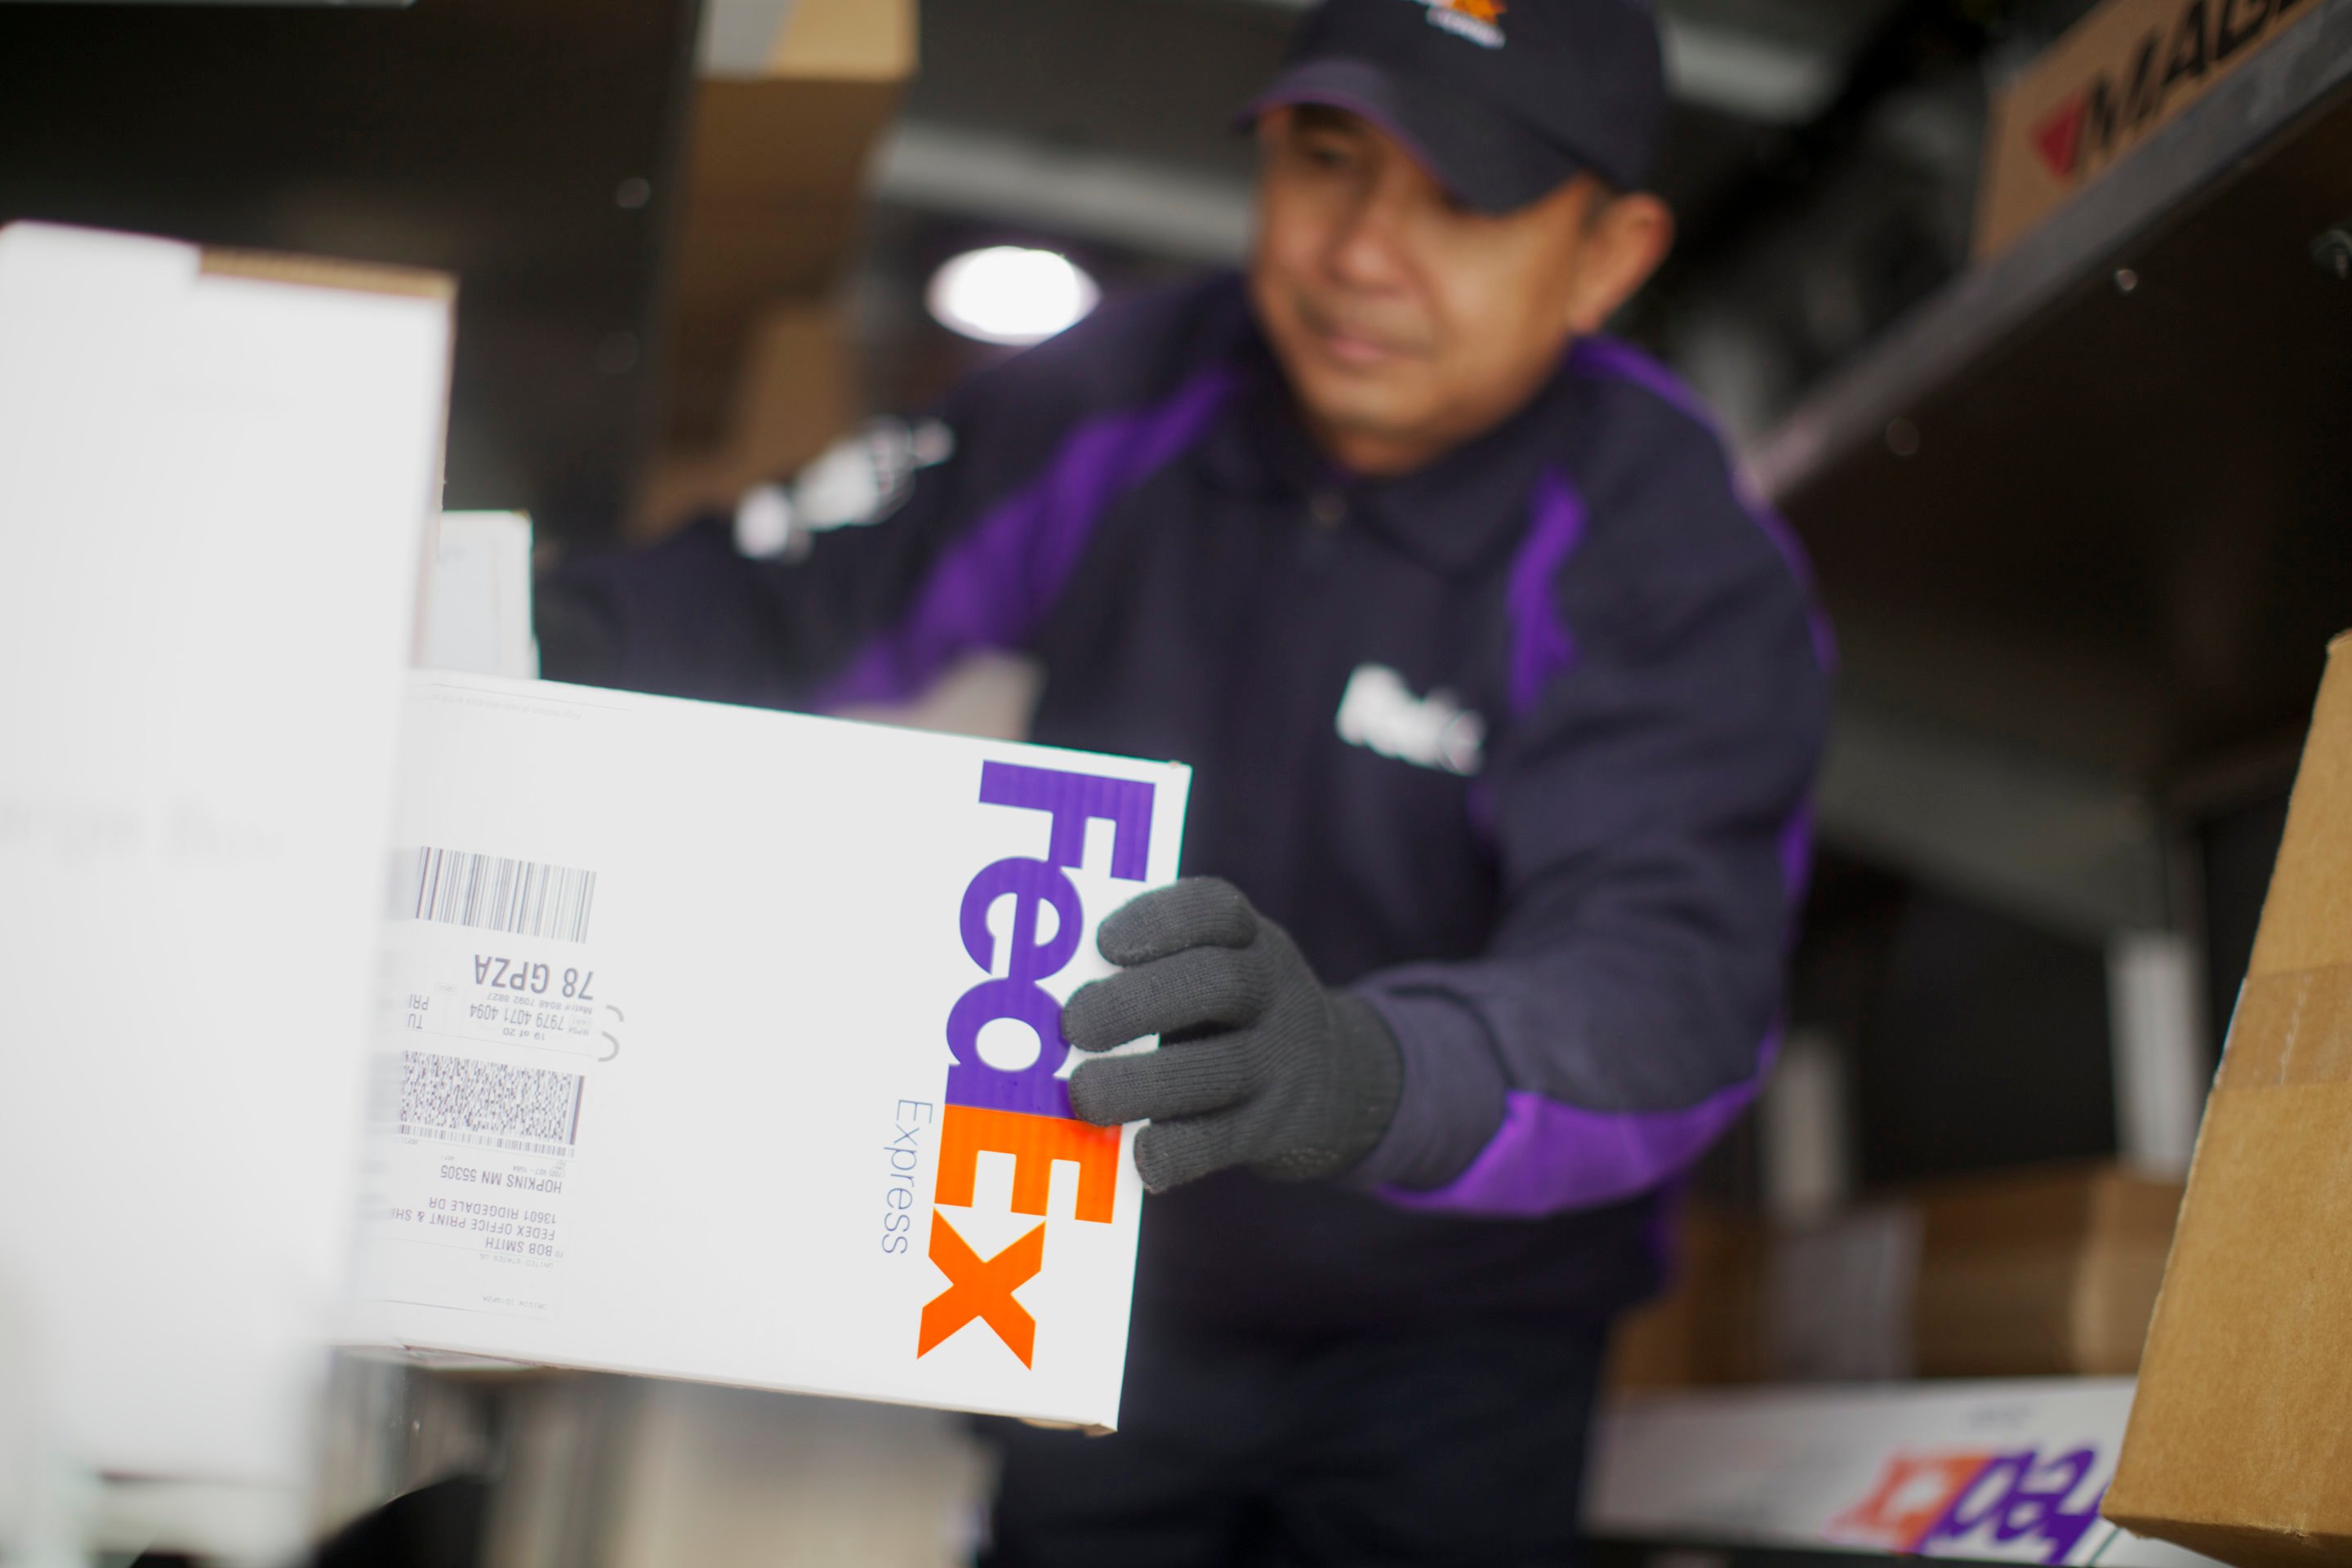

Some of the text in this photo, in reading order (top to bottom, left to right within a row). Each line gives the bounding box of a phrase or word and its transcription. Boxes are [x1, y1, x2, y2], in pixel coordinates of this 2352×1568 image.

[474, 954, 594, 1000] 78 GPZA
[408, 994, 430, 1010] PRI
[513, 996, 535, 1006] 7092
[470, 1003, 499, 1021] 4094
[504, 1007, 532, 1026] 4071
[408, 1013, 423, 1030] TU
[536, 1013, 564, 1031] 7979
[503, 1027, 546, 1040] 19 of 20
[916, 760, 1156, 1371] FedEx
[440, 1165, 562, 1194] HOPKINS MN 55305
[882, 1099, 933, 1254] Express
[429, 1196, 557, 1224] 13601 RIDGEDALE DR
[390, 1208, 555, 1241] FEDEX OFFICE PRINT & SHI
[485, 1236, 524, 1253] SMITH
[529, 1243, 553, 1257] BOB
